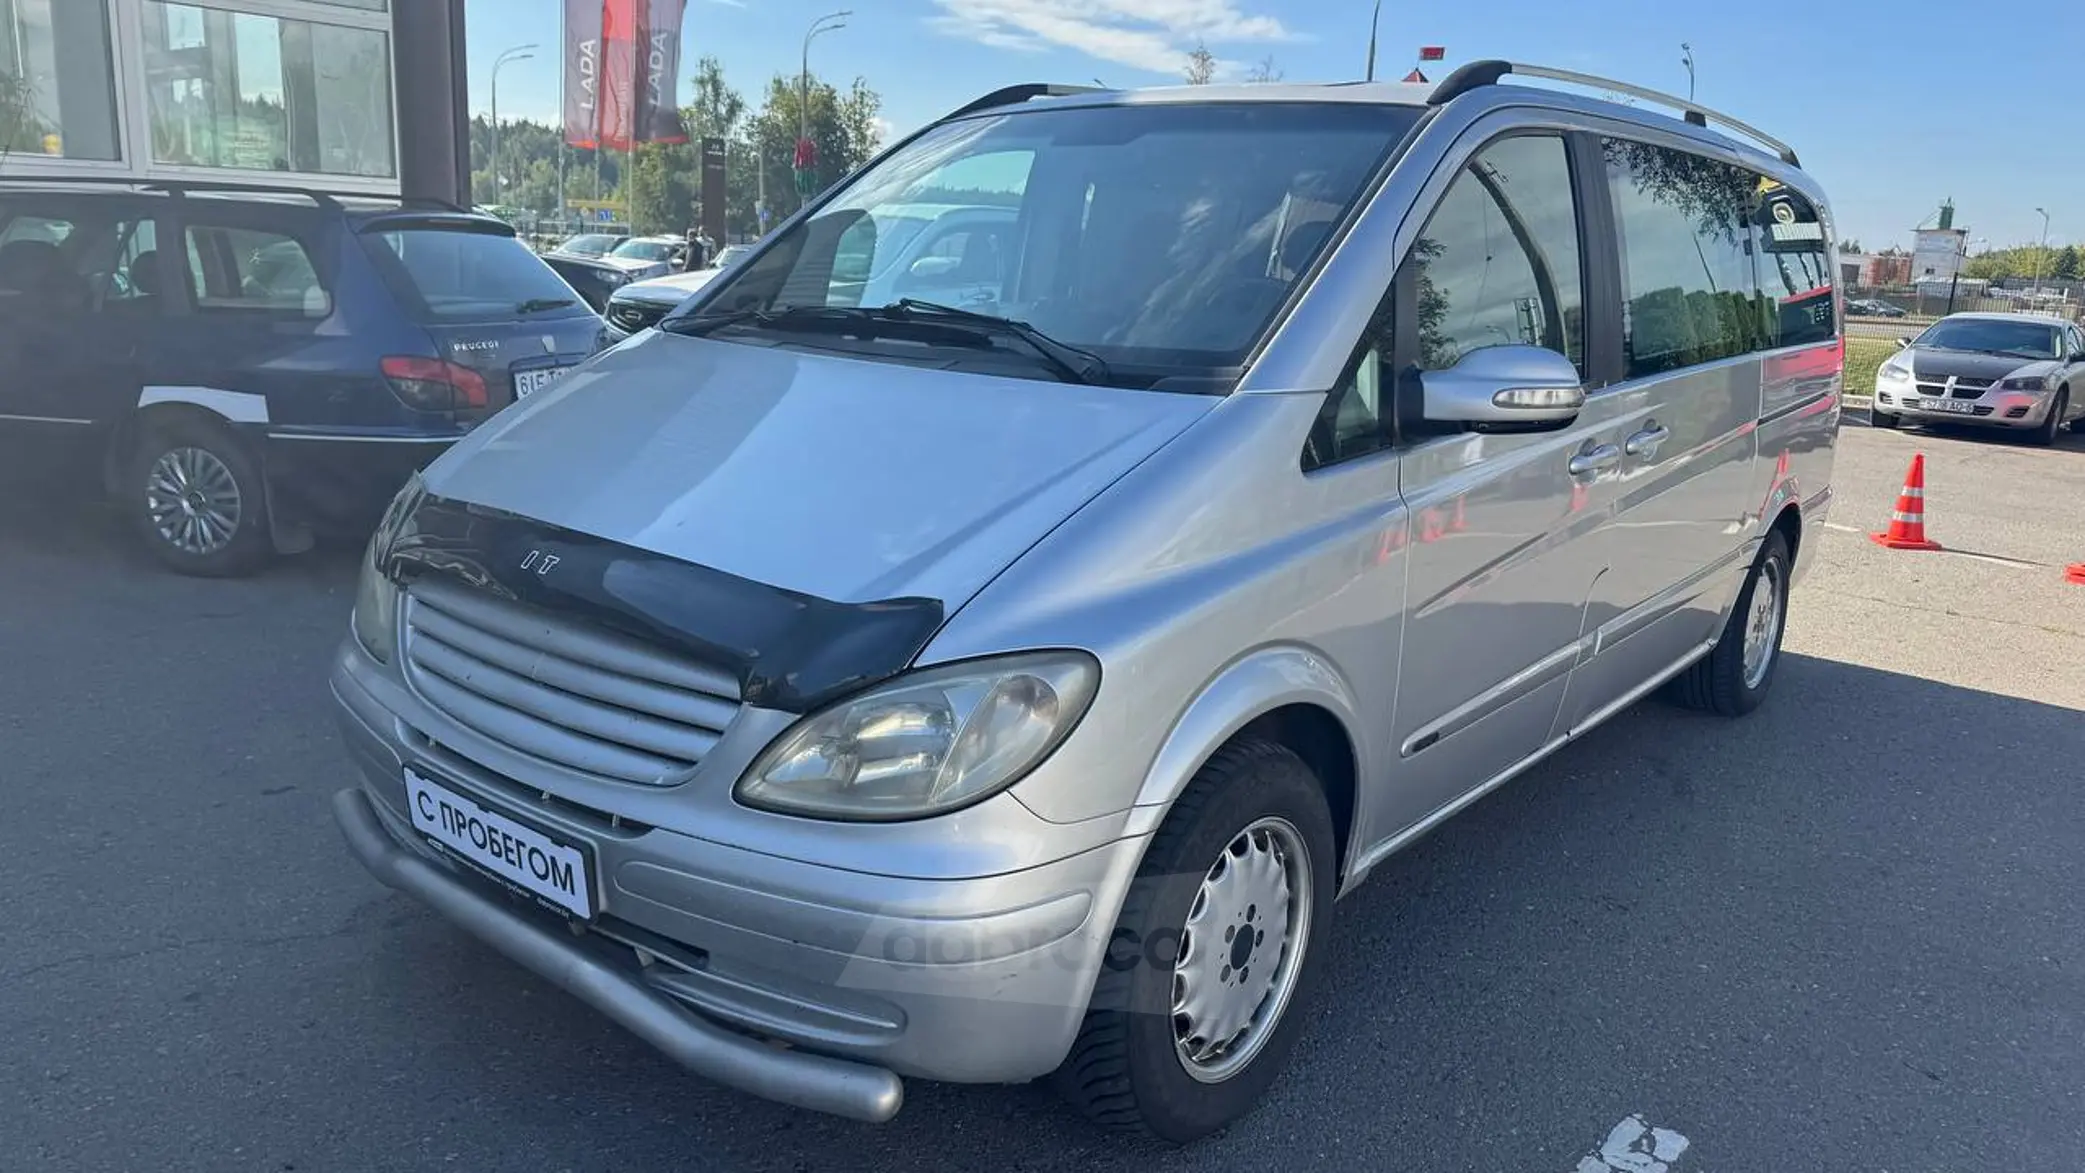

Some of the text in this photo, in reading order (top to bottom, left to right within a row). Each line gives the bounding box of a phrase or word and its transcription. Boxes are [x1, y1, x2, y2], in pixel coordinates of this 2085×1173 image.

[579, 39, 597, 110] LADA
[648, 32, 668, 107] LADA
[417, 790, 435, 822] С
[439, 800, 576, 896] ПРОБЕГОМ
